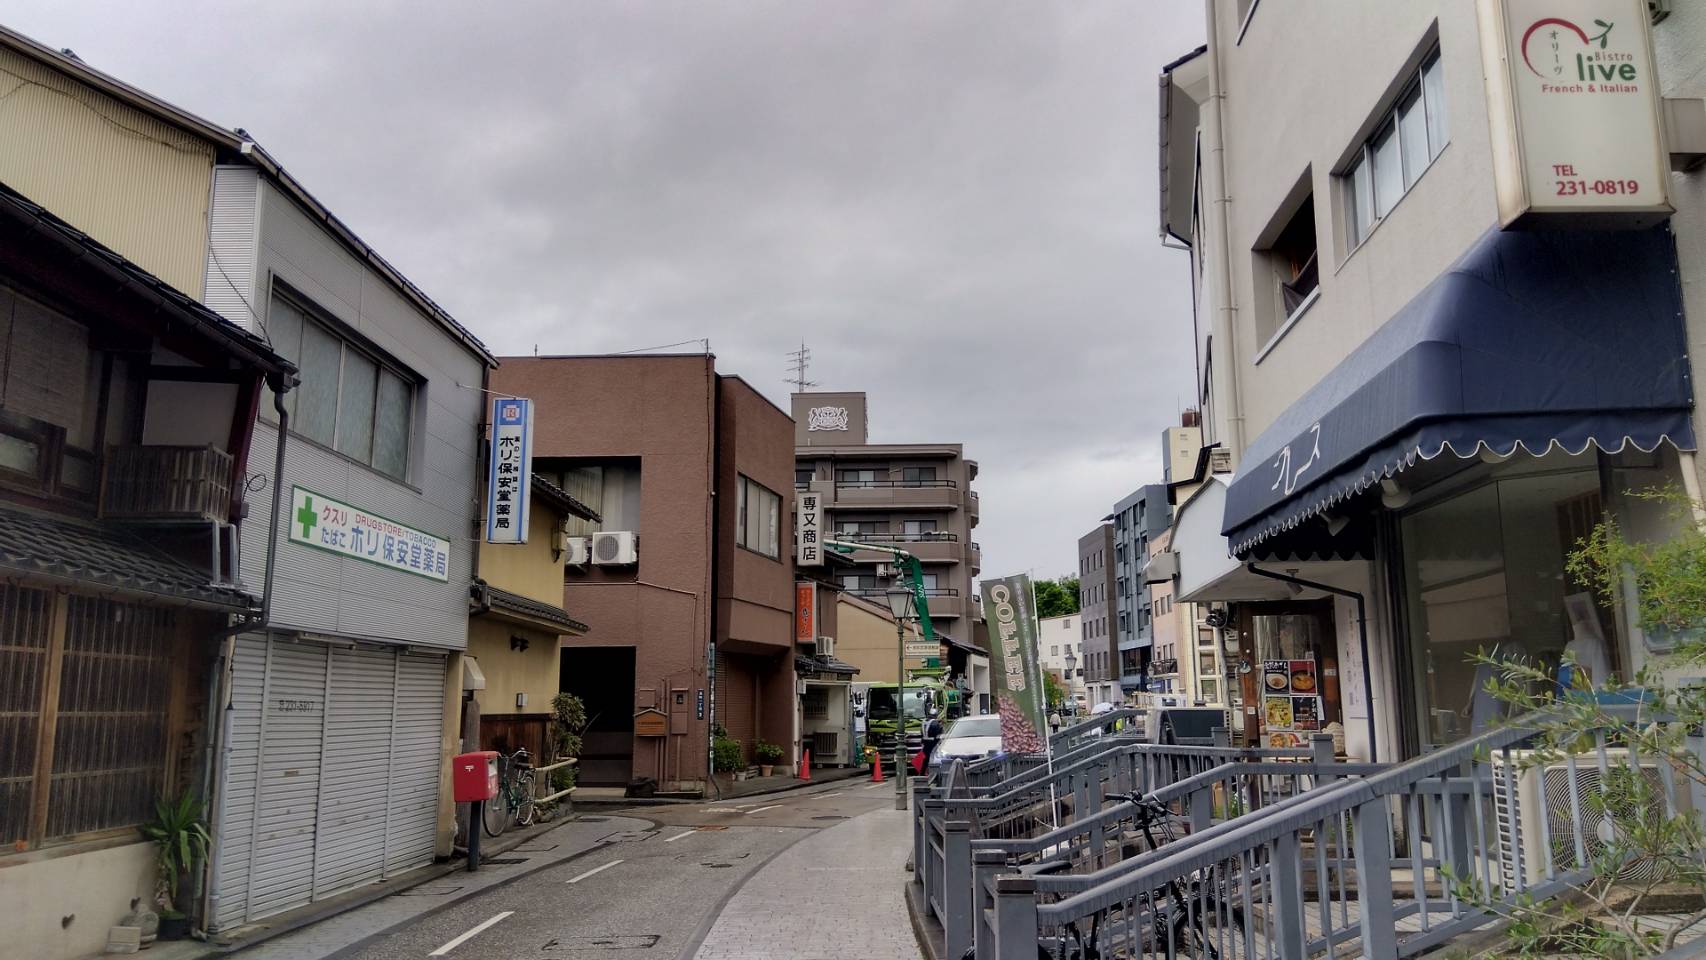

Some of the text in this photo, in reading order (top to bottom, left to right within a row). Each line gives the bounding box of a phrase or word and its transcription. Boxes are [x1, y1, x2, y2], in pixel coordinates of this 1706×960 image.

[1549, 30, 1563, 75] オリーヴ
[1595, 52, 1633, 61] Bistro
[1576, 53, 1636, 81] live
[1542, 84, 1638, 93] French & Italian
[1553, 165, 1577, 176] TEL
[1556, 180, 1638, 196] 231-0819
[495, 436, 514, 529] ホリ保安堂薬局
[322, 505, 348, 527] クスリ
[802, 496, 817, 560] 専又商店
[321, 526, 347, 547] たばこ
[350, 526, 446, 576] ホリ保安堂薬局
[991, 584, 1026, 691] COFFEE
